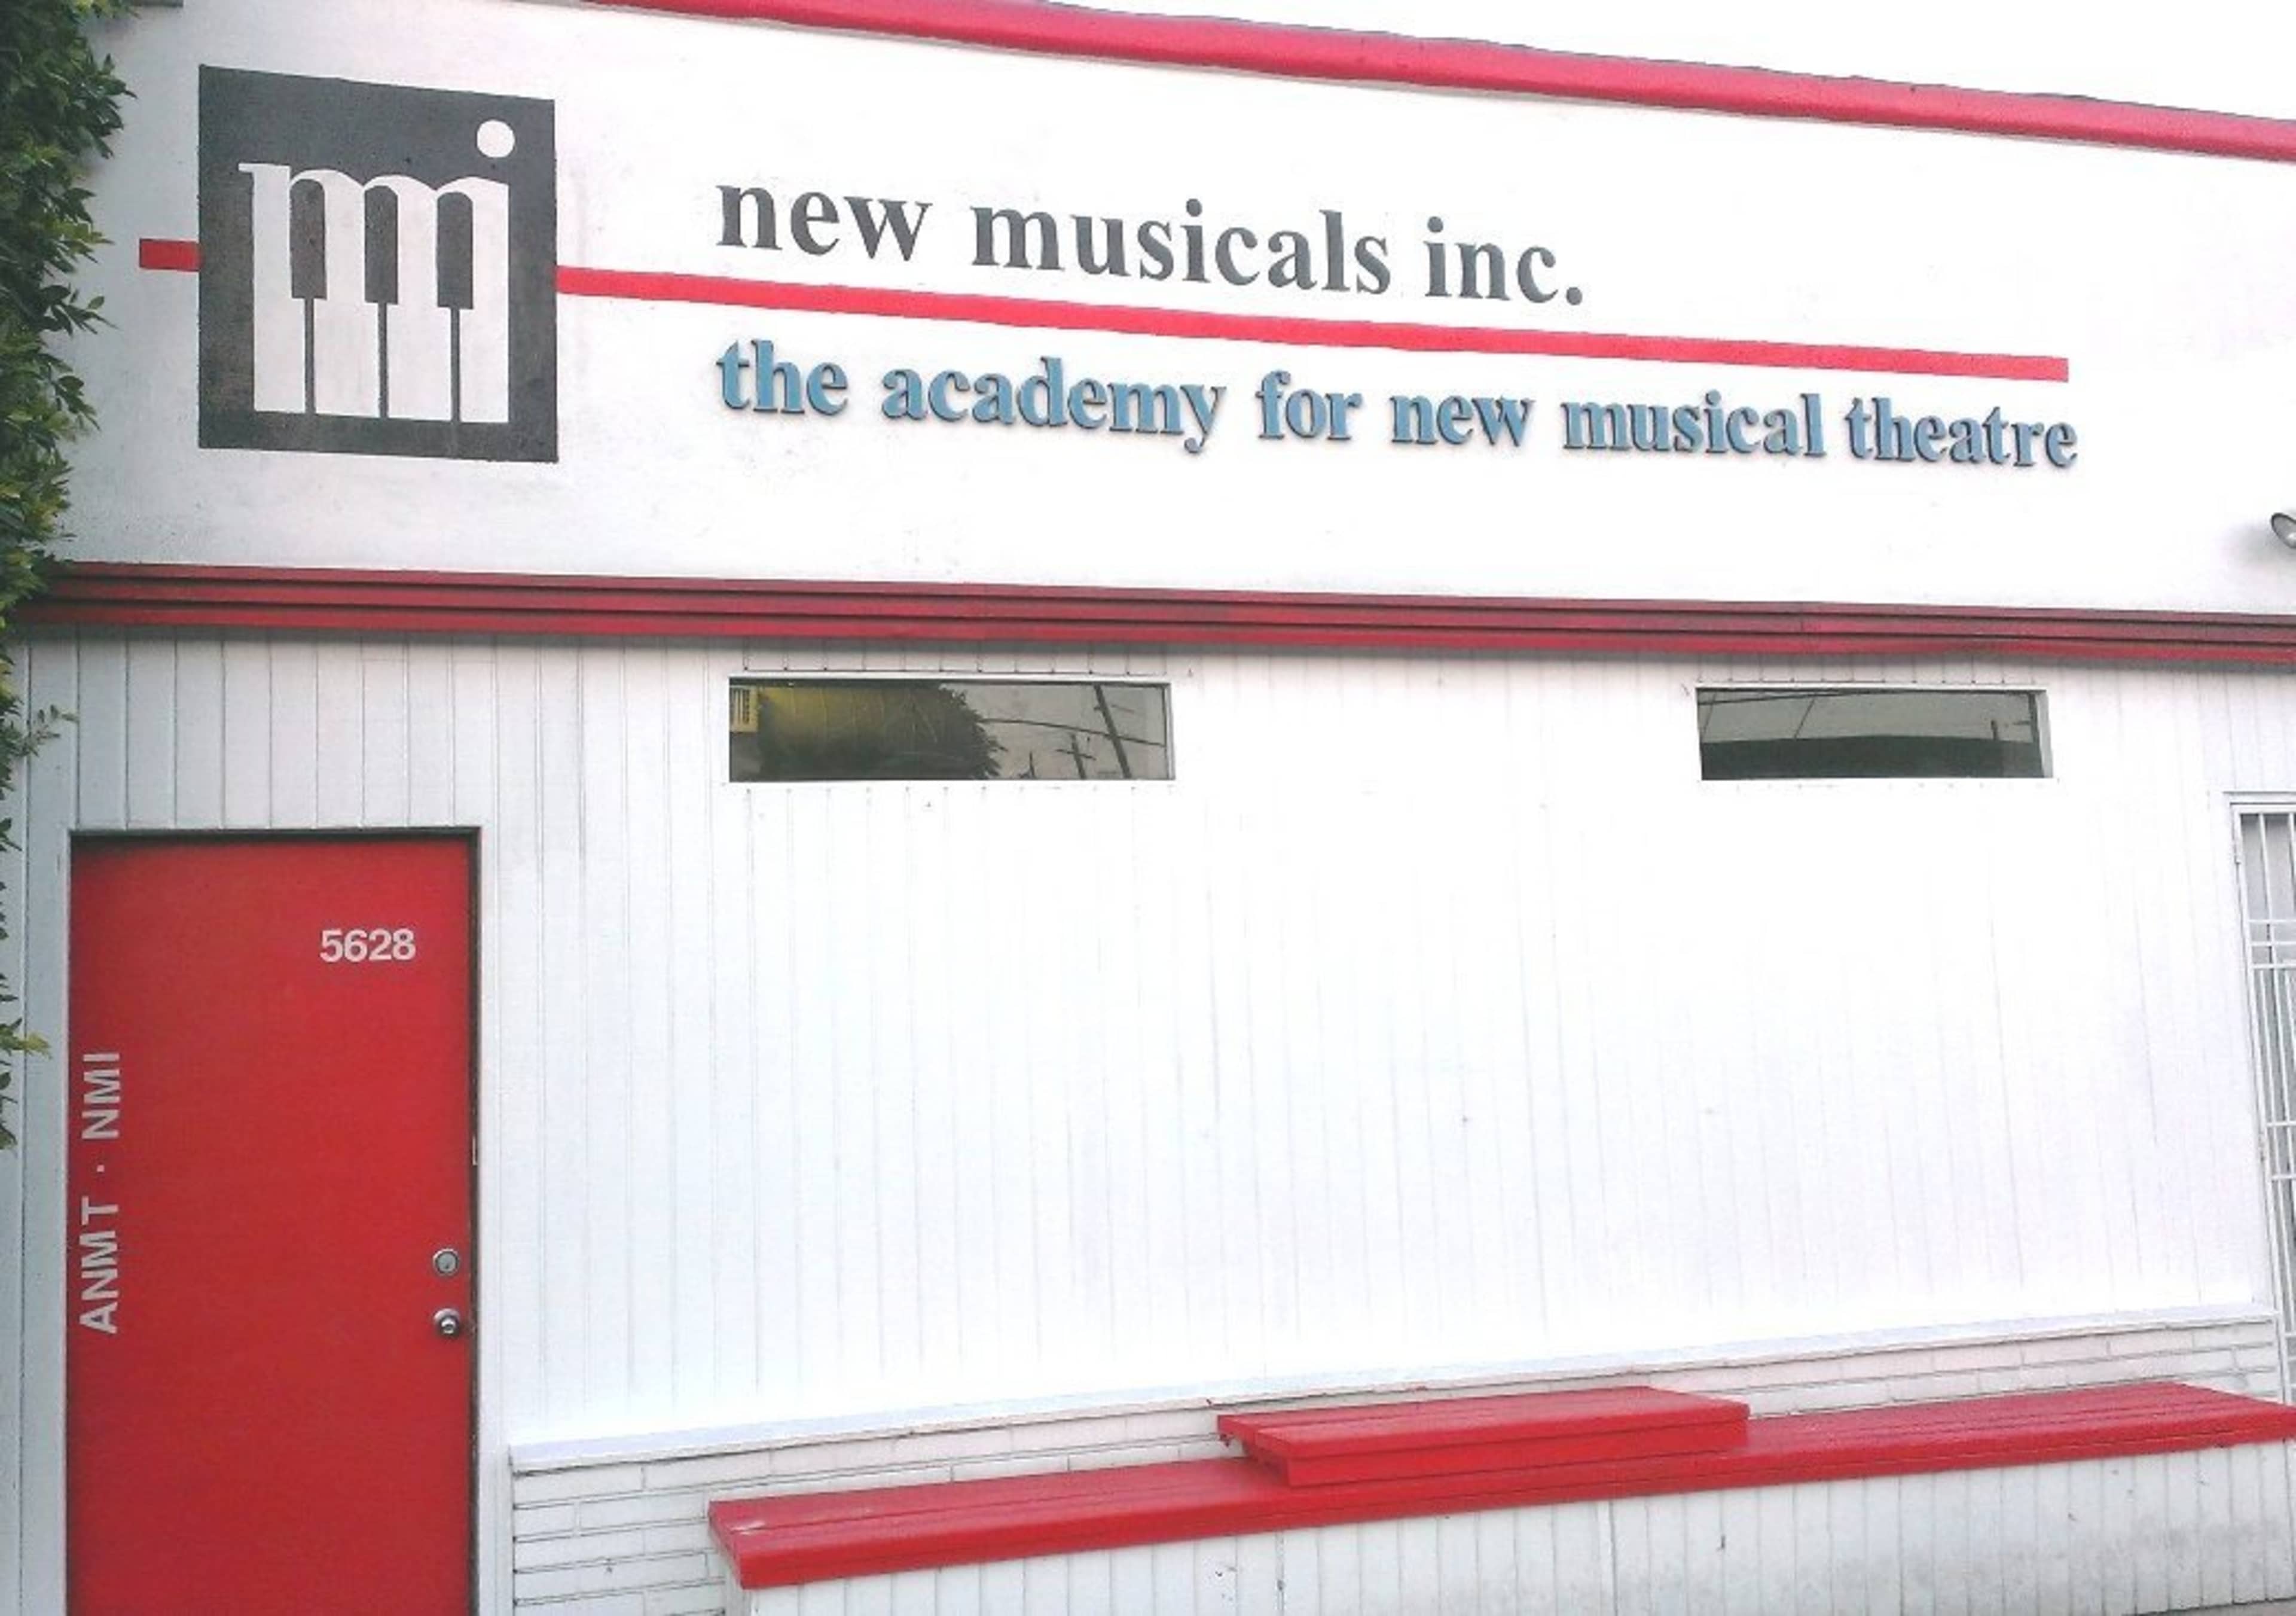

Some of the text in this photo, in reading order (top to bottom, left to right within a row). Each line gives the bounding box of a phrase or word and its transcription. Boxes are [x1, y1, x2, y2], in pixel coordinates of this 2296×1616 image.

[716, 185, 1583, 306] new musicals inc.
[715, 339, 2078, 469] the academy for new musical theatre
[320, 928, 417, 963] 5628
[80, 1053, 120, 1334] ANMT NMI
